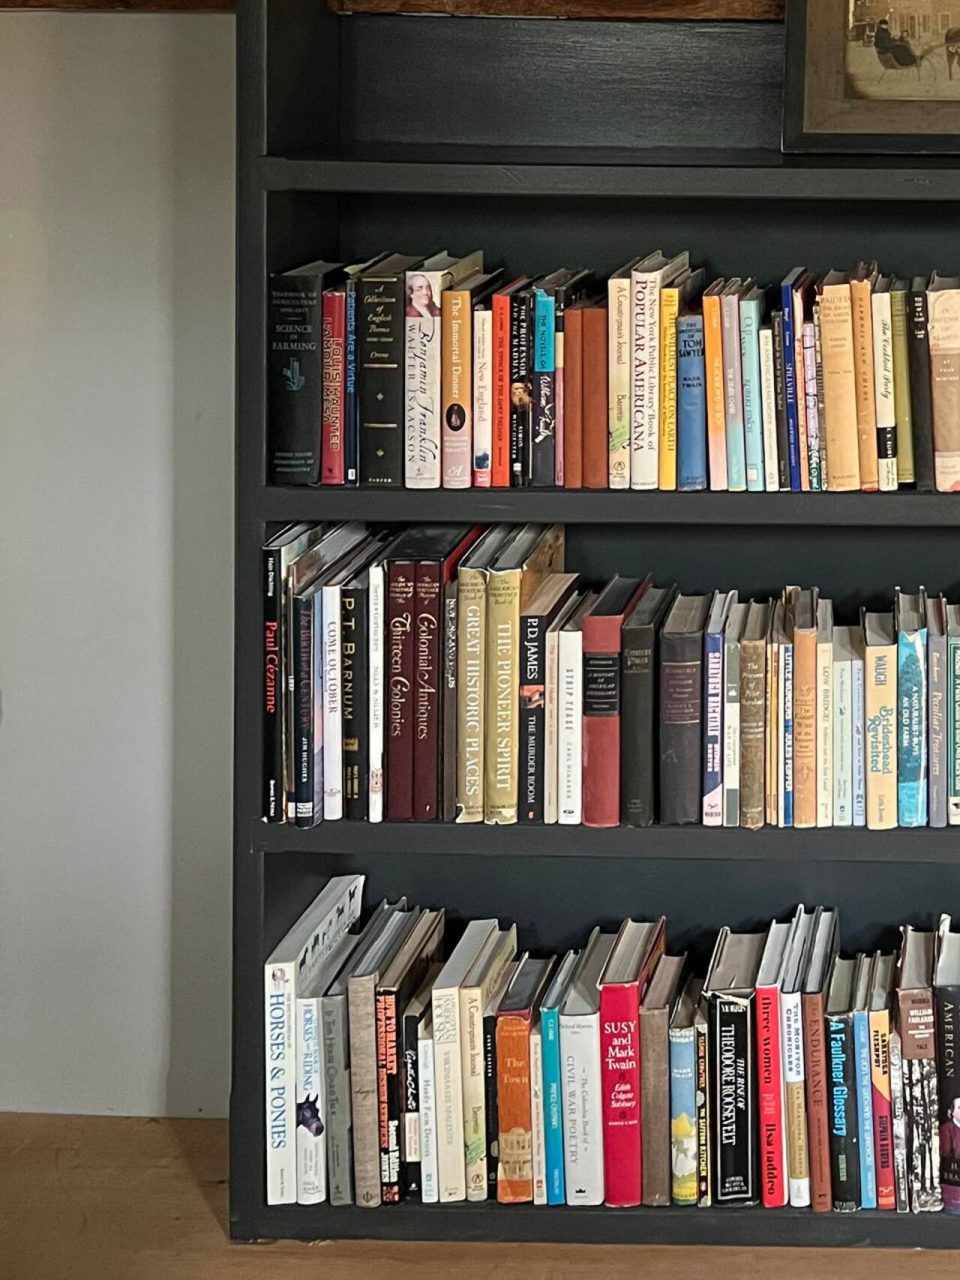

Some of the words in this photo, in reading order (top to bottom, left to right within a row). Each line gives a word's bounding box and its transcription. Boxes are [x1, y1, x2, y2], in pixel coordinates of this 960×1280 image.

[452, 297, 462, 316] The
[635, 280, 647, 352] POPULAR
[668, 312, 676, 330] THE
[331, 338, 341, 381] LOUIS
[408, 324, 416, 381] WALTER
[452, 320, 462, 362] Immortal
[519, 322, 527, 377] PROFESSOR
[668, 332, 677, 373] WILDEST
[682, 339, 702, 349] TOM
[452, 366, 461, 399] Dinner
[477, 361, 487, 383] New
[668, 375, 676, 404] PLACE
[330, 388, 339, 452] HAUNTED
[476, 385, 487, 422] England
[633, 356, 646, 452] AMERICANA
[668, 406, 675, 419] ON
[407, 389, 417, 463] ISAACSON
[667, 421, 675, 452] EARTH
[265, 620, 278, 654] Paul
[328, 621, 338, 656] COME
[389, 613, 409, 674] Thirteen
[417, 613, 437, 671] Colonial
[466, 605, 481, 655] GREAT
[497, 622, 512, 656] THE
[265, 655, 279, 714] Cézanne
[328, 659, 338, 714] OCTOBER
[343, 642, 355, 720] BARNUM
[874, 655, 887, 686] WAUGH
[390, 676, 409, 737] Colonies
[416, 670, 435, 740] Antiques
[466, 659, 480, 733] HISTORIC
[497, 660, 512, 735] PIONEER
[528, 715, 536, 734] THE
[868, 715, 881, 773] Revisited
[881, 706, 893, 775] Brideshead
[301, 752, 309, 783] HUGHES
[466, 738, 479, 795] PLACES
[496, 738, 511, 790] SPIRIT
[528, 735, 536, 774] MURDER
[528, 776, 536, 803] ROOM
[269, 993, 286, 1061] HORSES
[302, 1004, 313, 1042] HORSES
[604, 1022, 636, 1034] SUSY
[761, 997, 772, 1032] three
[830, 1022, 844, 1030] A
[607, 1047, 634, 1058] Mark
[611, 1037, 631, 1045] and
[721, 1024, 734, 1084] THEODORE
[763, 1036, 773, 1084] women
[832, 1034, 845, 1084] Faulkner
[943, 1001, 955, 1077] AMERICAN
[270, 1066, 286, 1081] &
[303, 1052, 313, 1092] RIDING
[567, 1056, 575, 1089] CIVIL
[605, 1058, 636, 1070] Twain
[271, 1086, 286, 1150] PONIES
[568, 1092, 576, 1116] WAR
[722, 1085, 736, 1146] ROOSEVELT
[832, 1086, 847, 1137] Glossary
[568, 1118, 577, 1165] POETRY
[765, 1123, 776, 1147] lisa
[766, 1150, 776, 1196] taddeo
